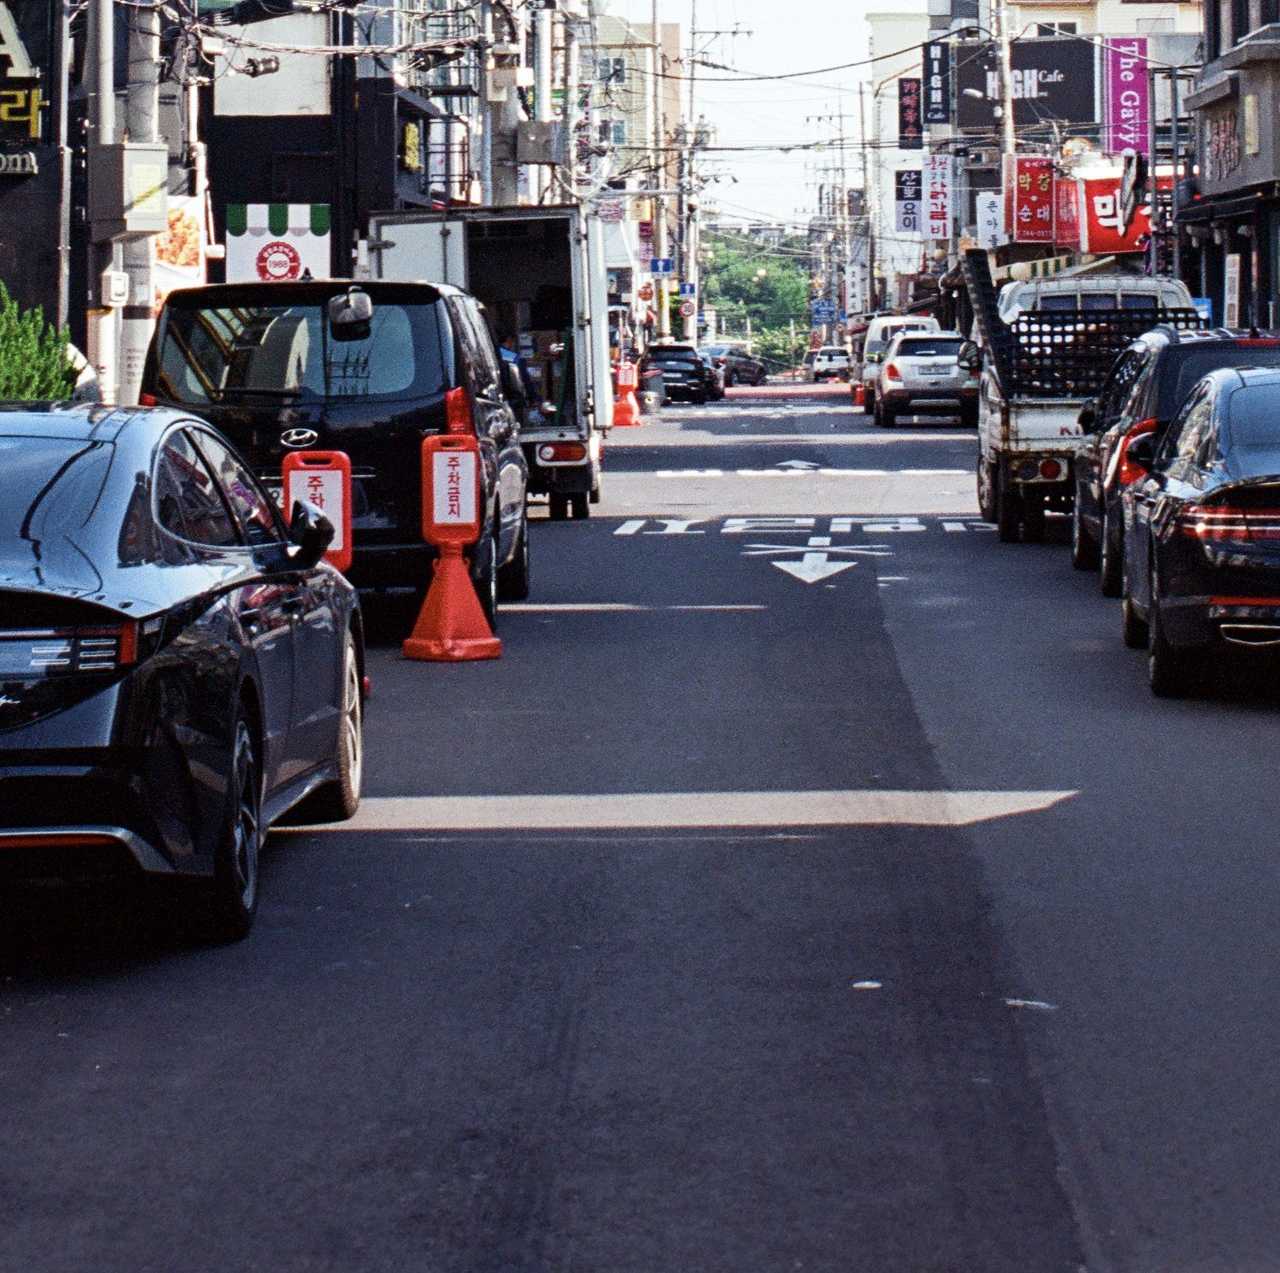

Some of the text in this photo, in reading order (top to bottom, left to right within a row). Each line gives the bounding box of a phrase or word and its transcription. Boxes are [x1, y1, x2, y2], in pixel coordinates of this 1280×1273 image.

[929, 45, 943, 103] HIGH
[1119, 41, 1140, 82] The
[986, 68, 1065, 100] HGH Cafe
[307, 475, 326, 508] 주차
[447, 456, 461, 519] 주차금지
